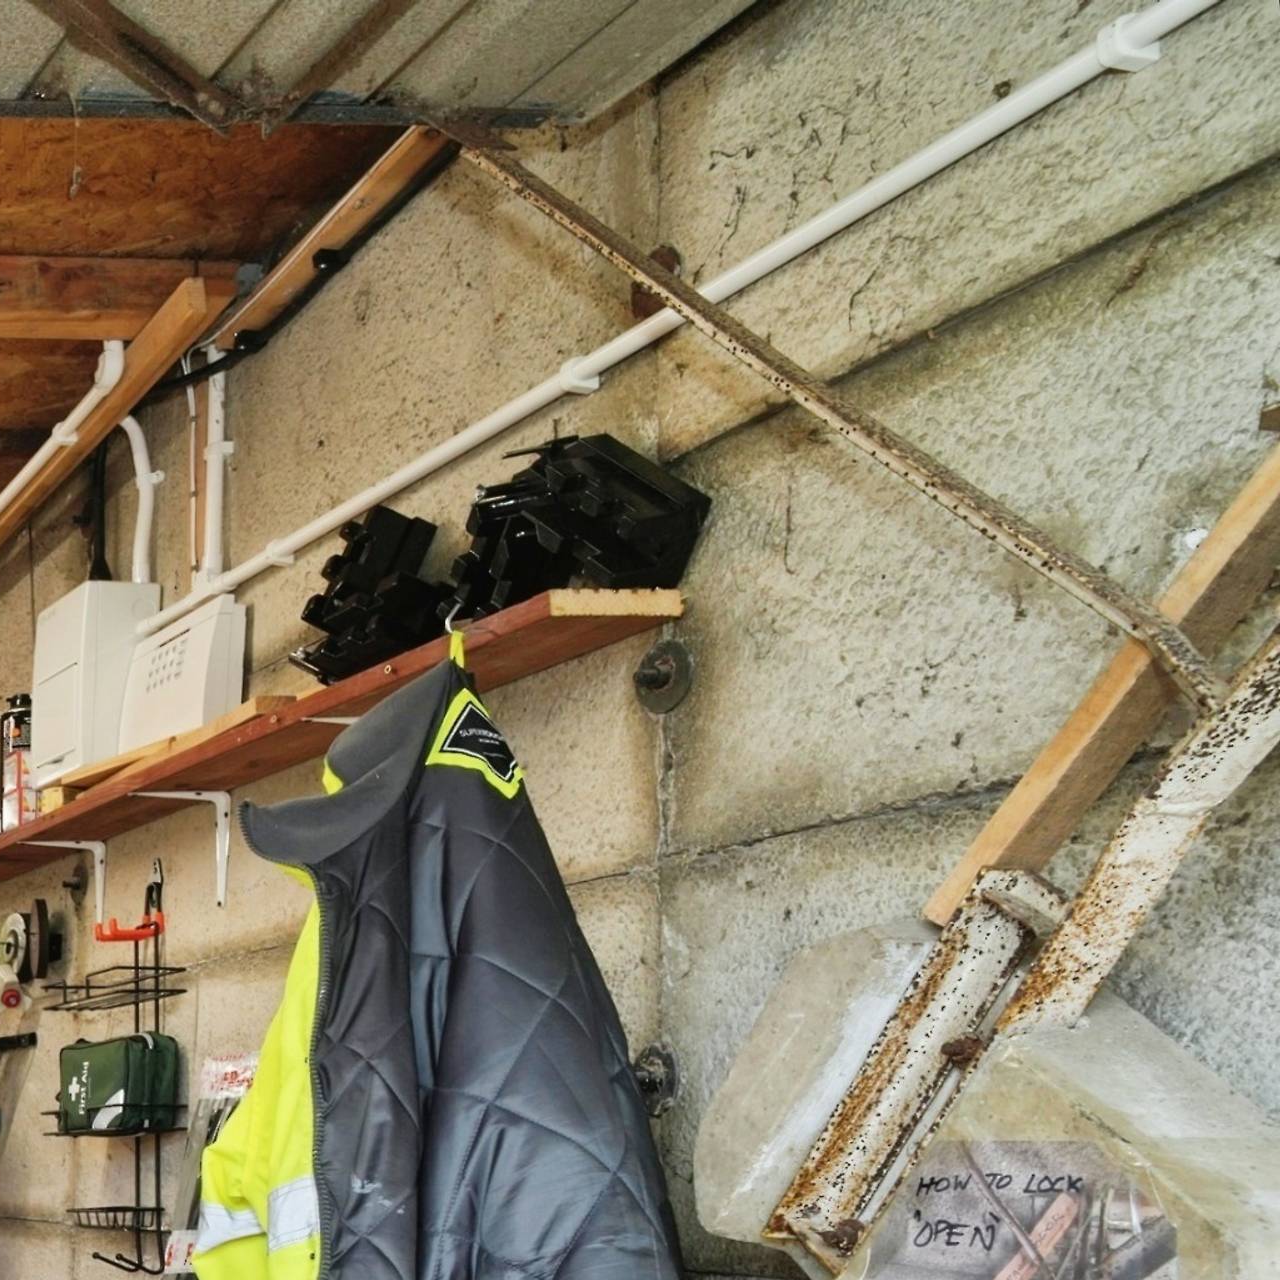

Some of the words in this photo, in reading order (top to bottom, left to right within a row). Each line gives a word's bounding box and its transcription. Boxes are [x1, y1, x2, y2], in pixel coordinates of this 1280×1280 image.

[80, 1061, 90, 1083] Aid
[78, 1087, 87, 1115] First
[915, 1173, 972, 1197] HOW
[985, 1172, 1013, 1190] TO
[1023, 1173, 1084, 1194] LOCK
